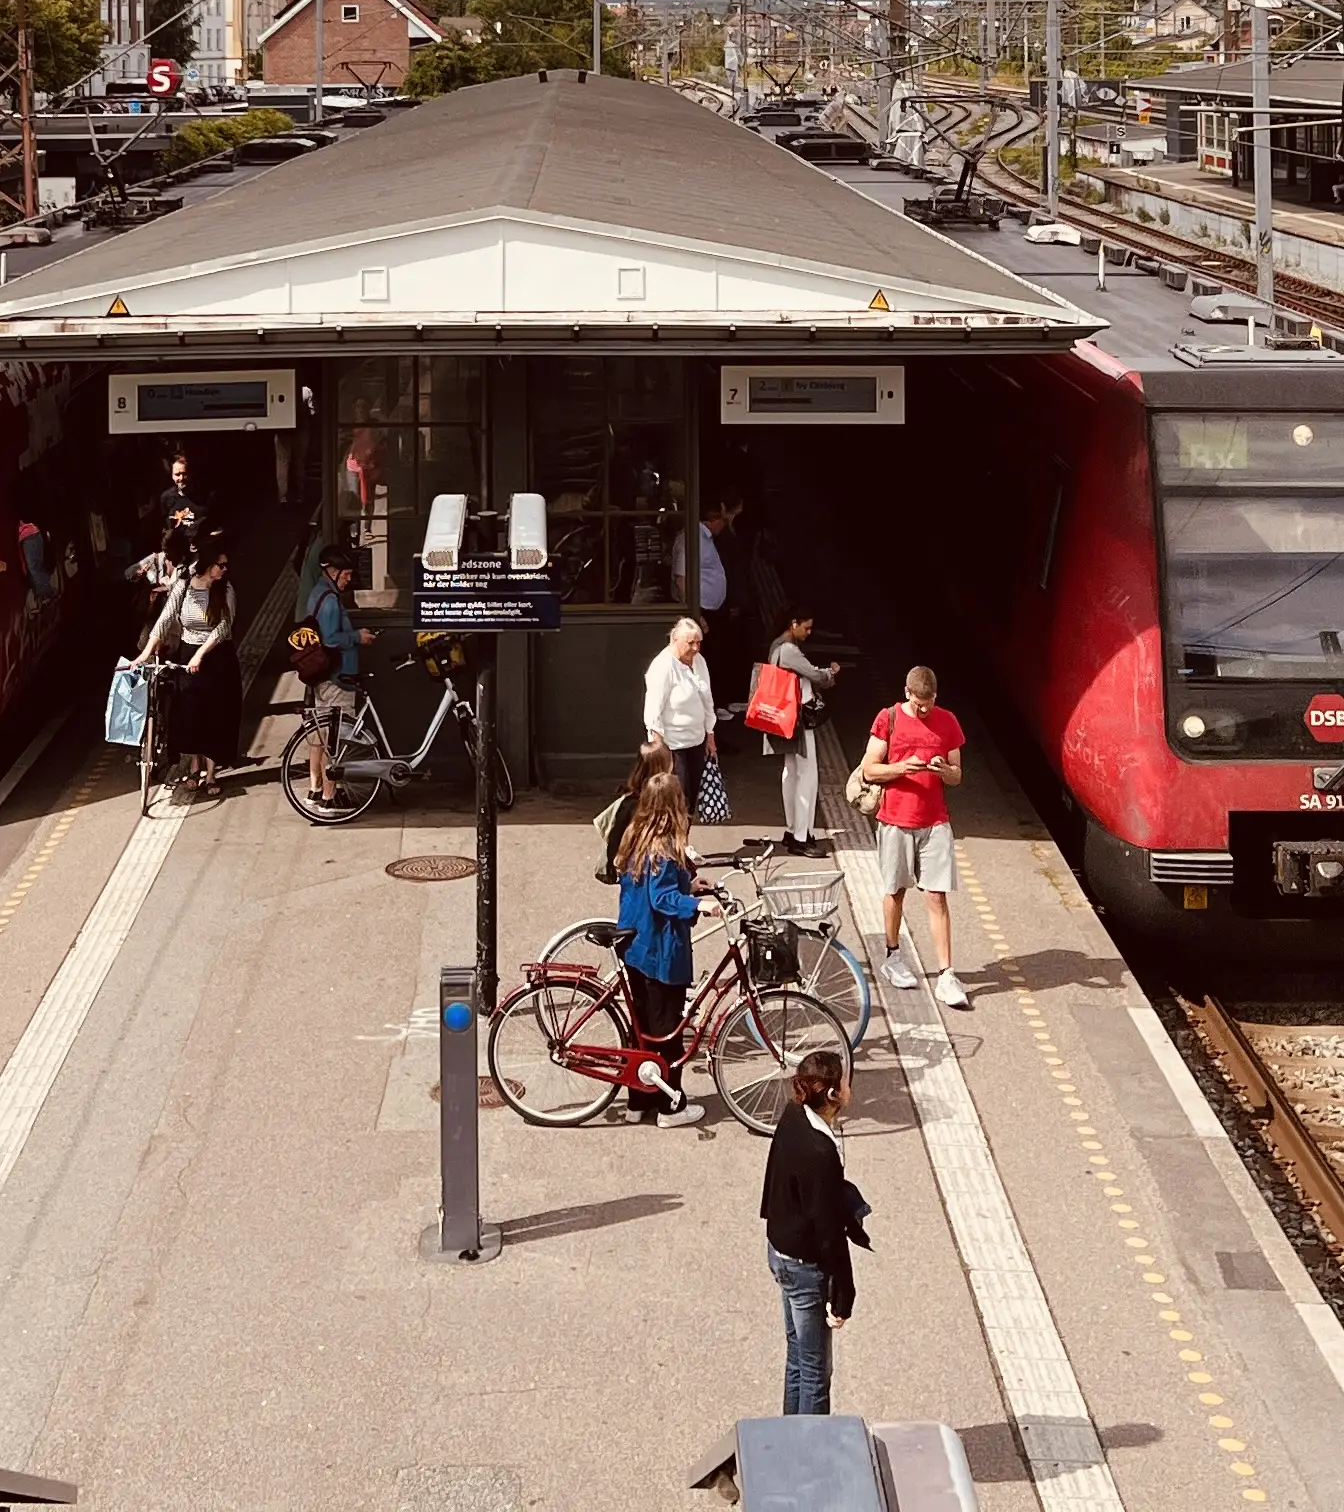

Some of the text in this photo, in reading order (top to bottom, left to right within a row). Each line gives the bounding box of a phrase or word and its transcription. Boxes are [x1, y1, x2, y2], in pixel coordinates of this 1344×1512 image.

[152, 65, 171, 93] S
[729, 389, 738, 400] 7
[117, 397, 127, 409] 8
[1299, 794, 1322, 809] SA
